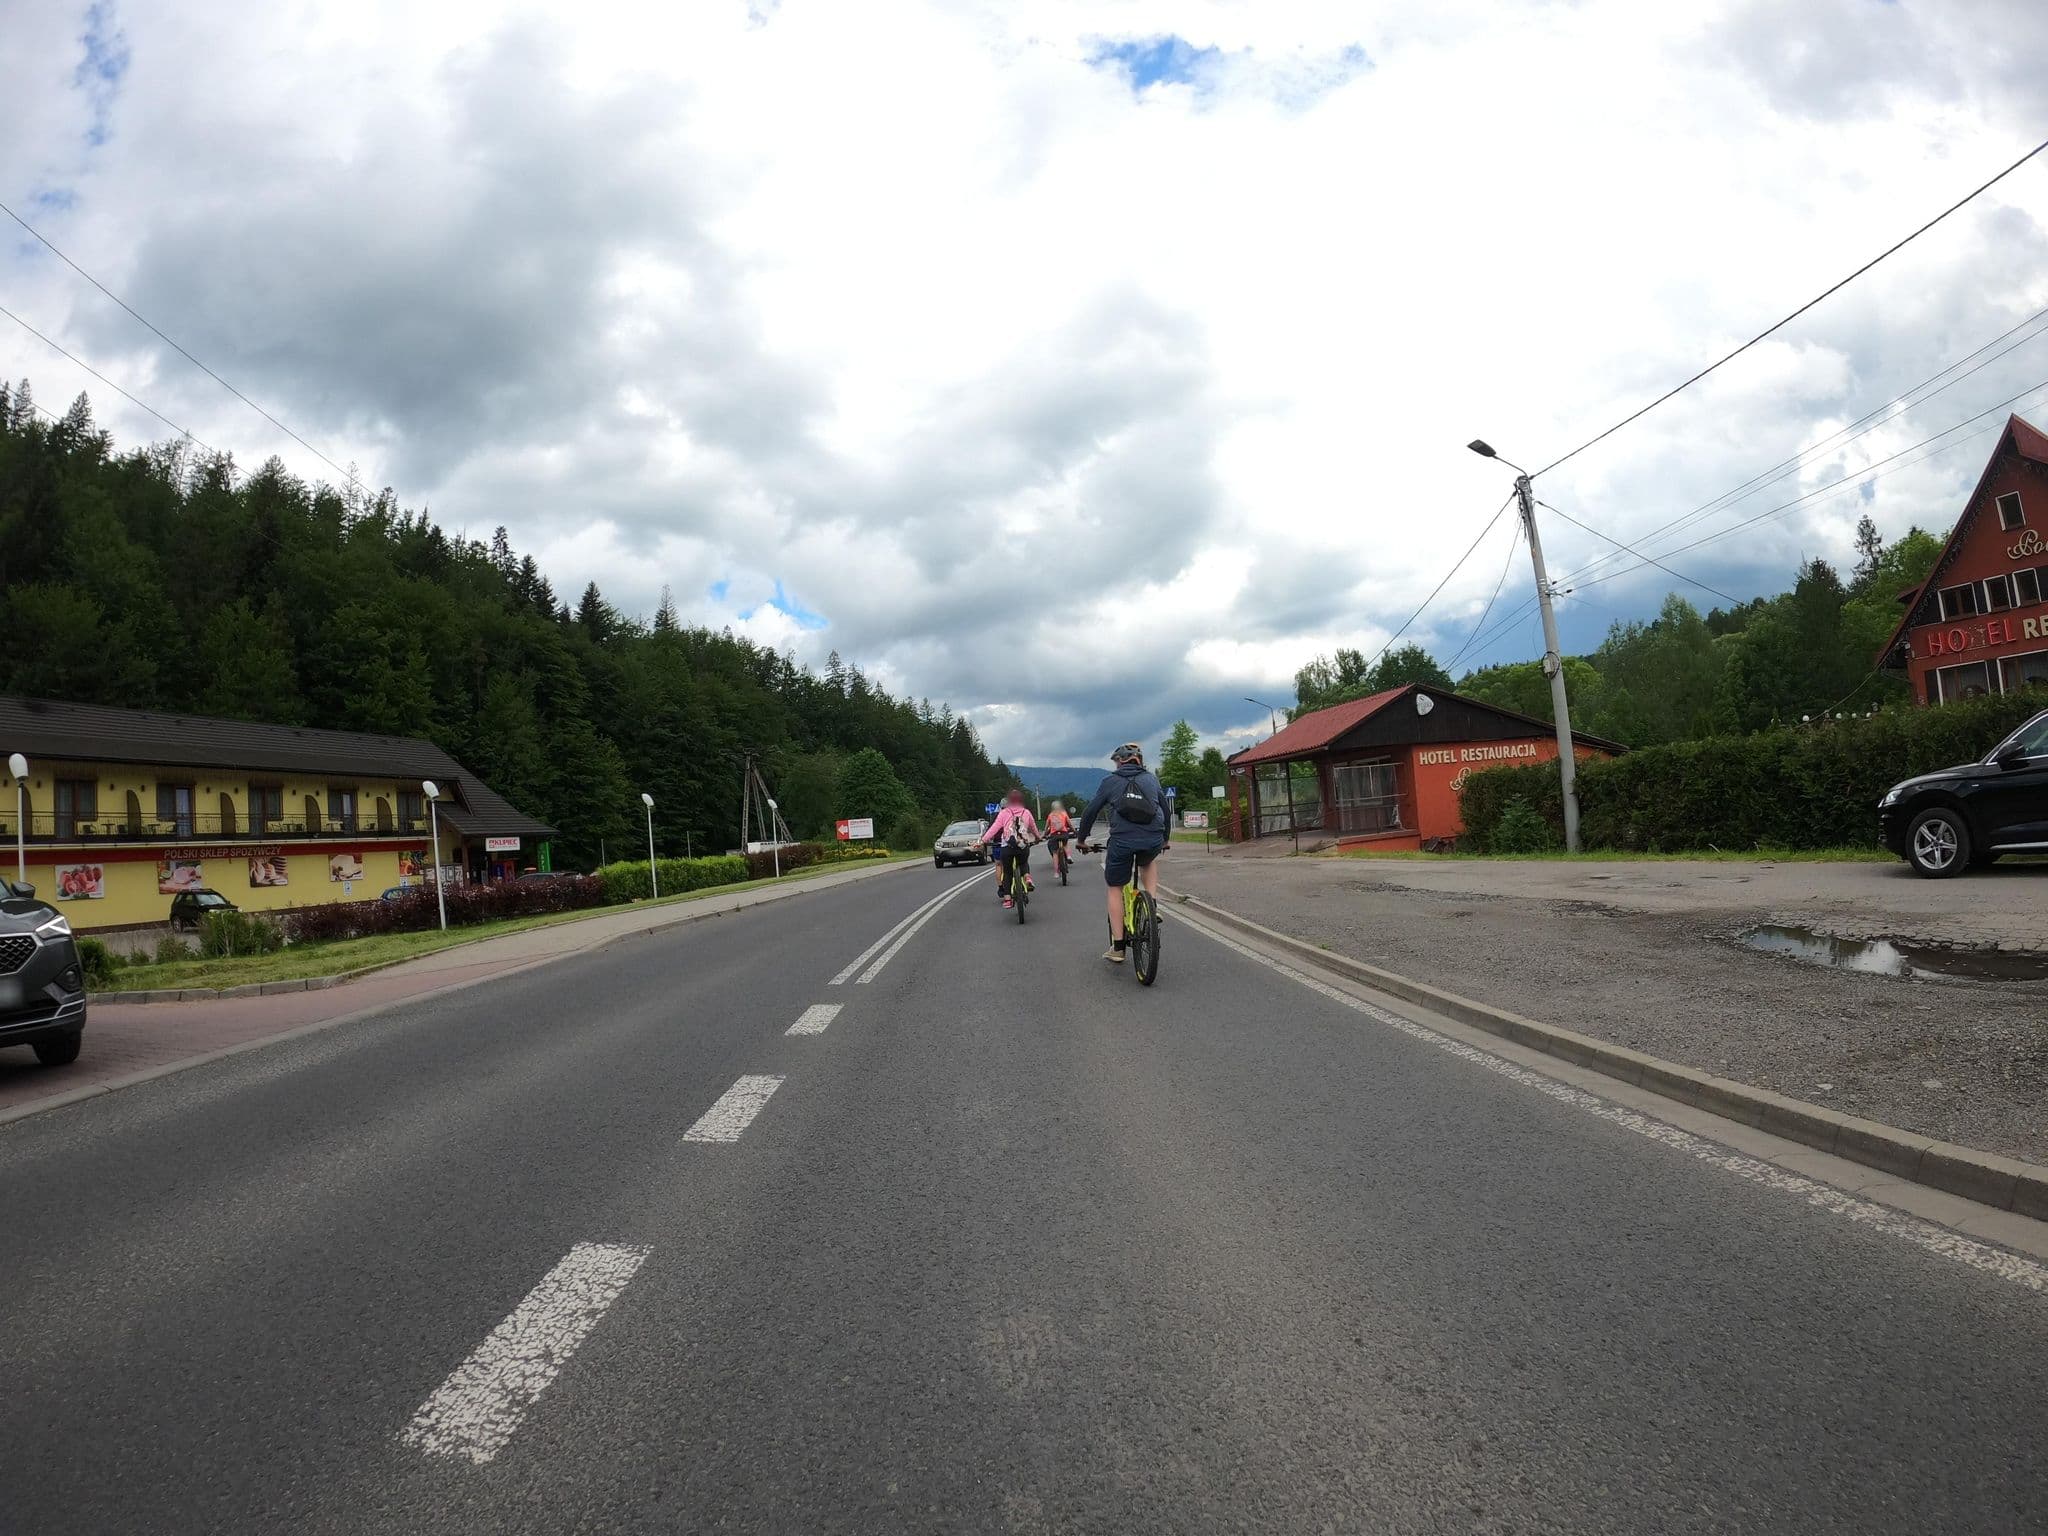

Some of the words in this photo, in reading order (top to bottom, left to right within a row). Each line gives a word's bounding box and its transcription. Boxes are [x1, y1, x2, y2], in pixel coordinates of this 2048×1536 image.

[2007, 529, 2048, 559] Po
[1928, 619, 2016, 656] HOTEL
[1420, 749, 1457, 765] HOTEL
[1461, 744, 1536, 761] RESTAURACJA
[164, 849, 198, 859] POLSKI
[200, 847, 229, 858] SKLEP
